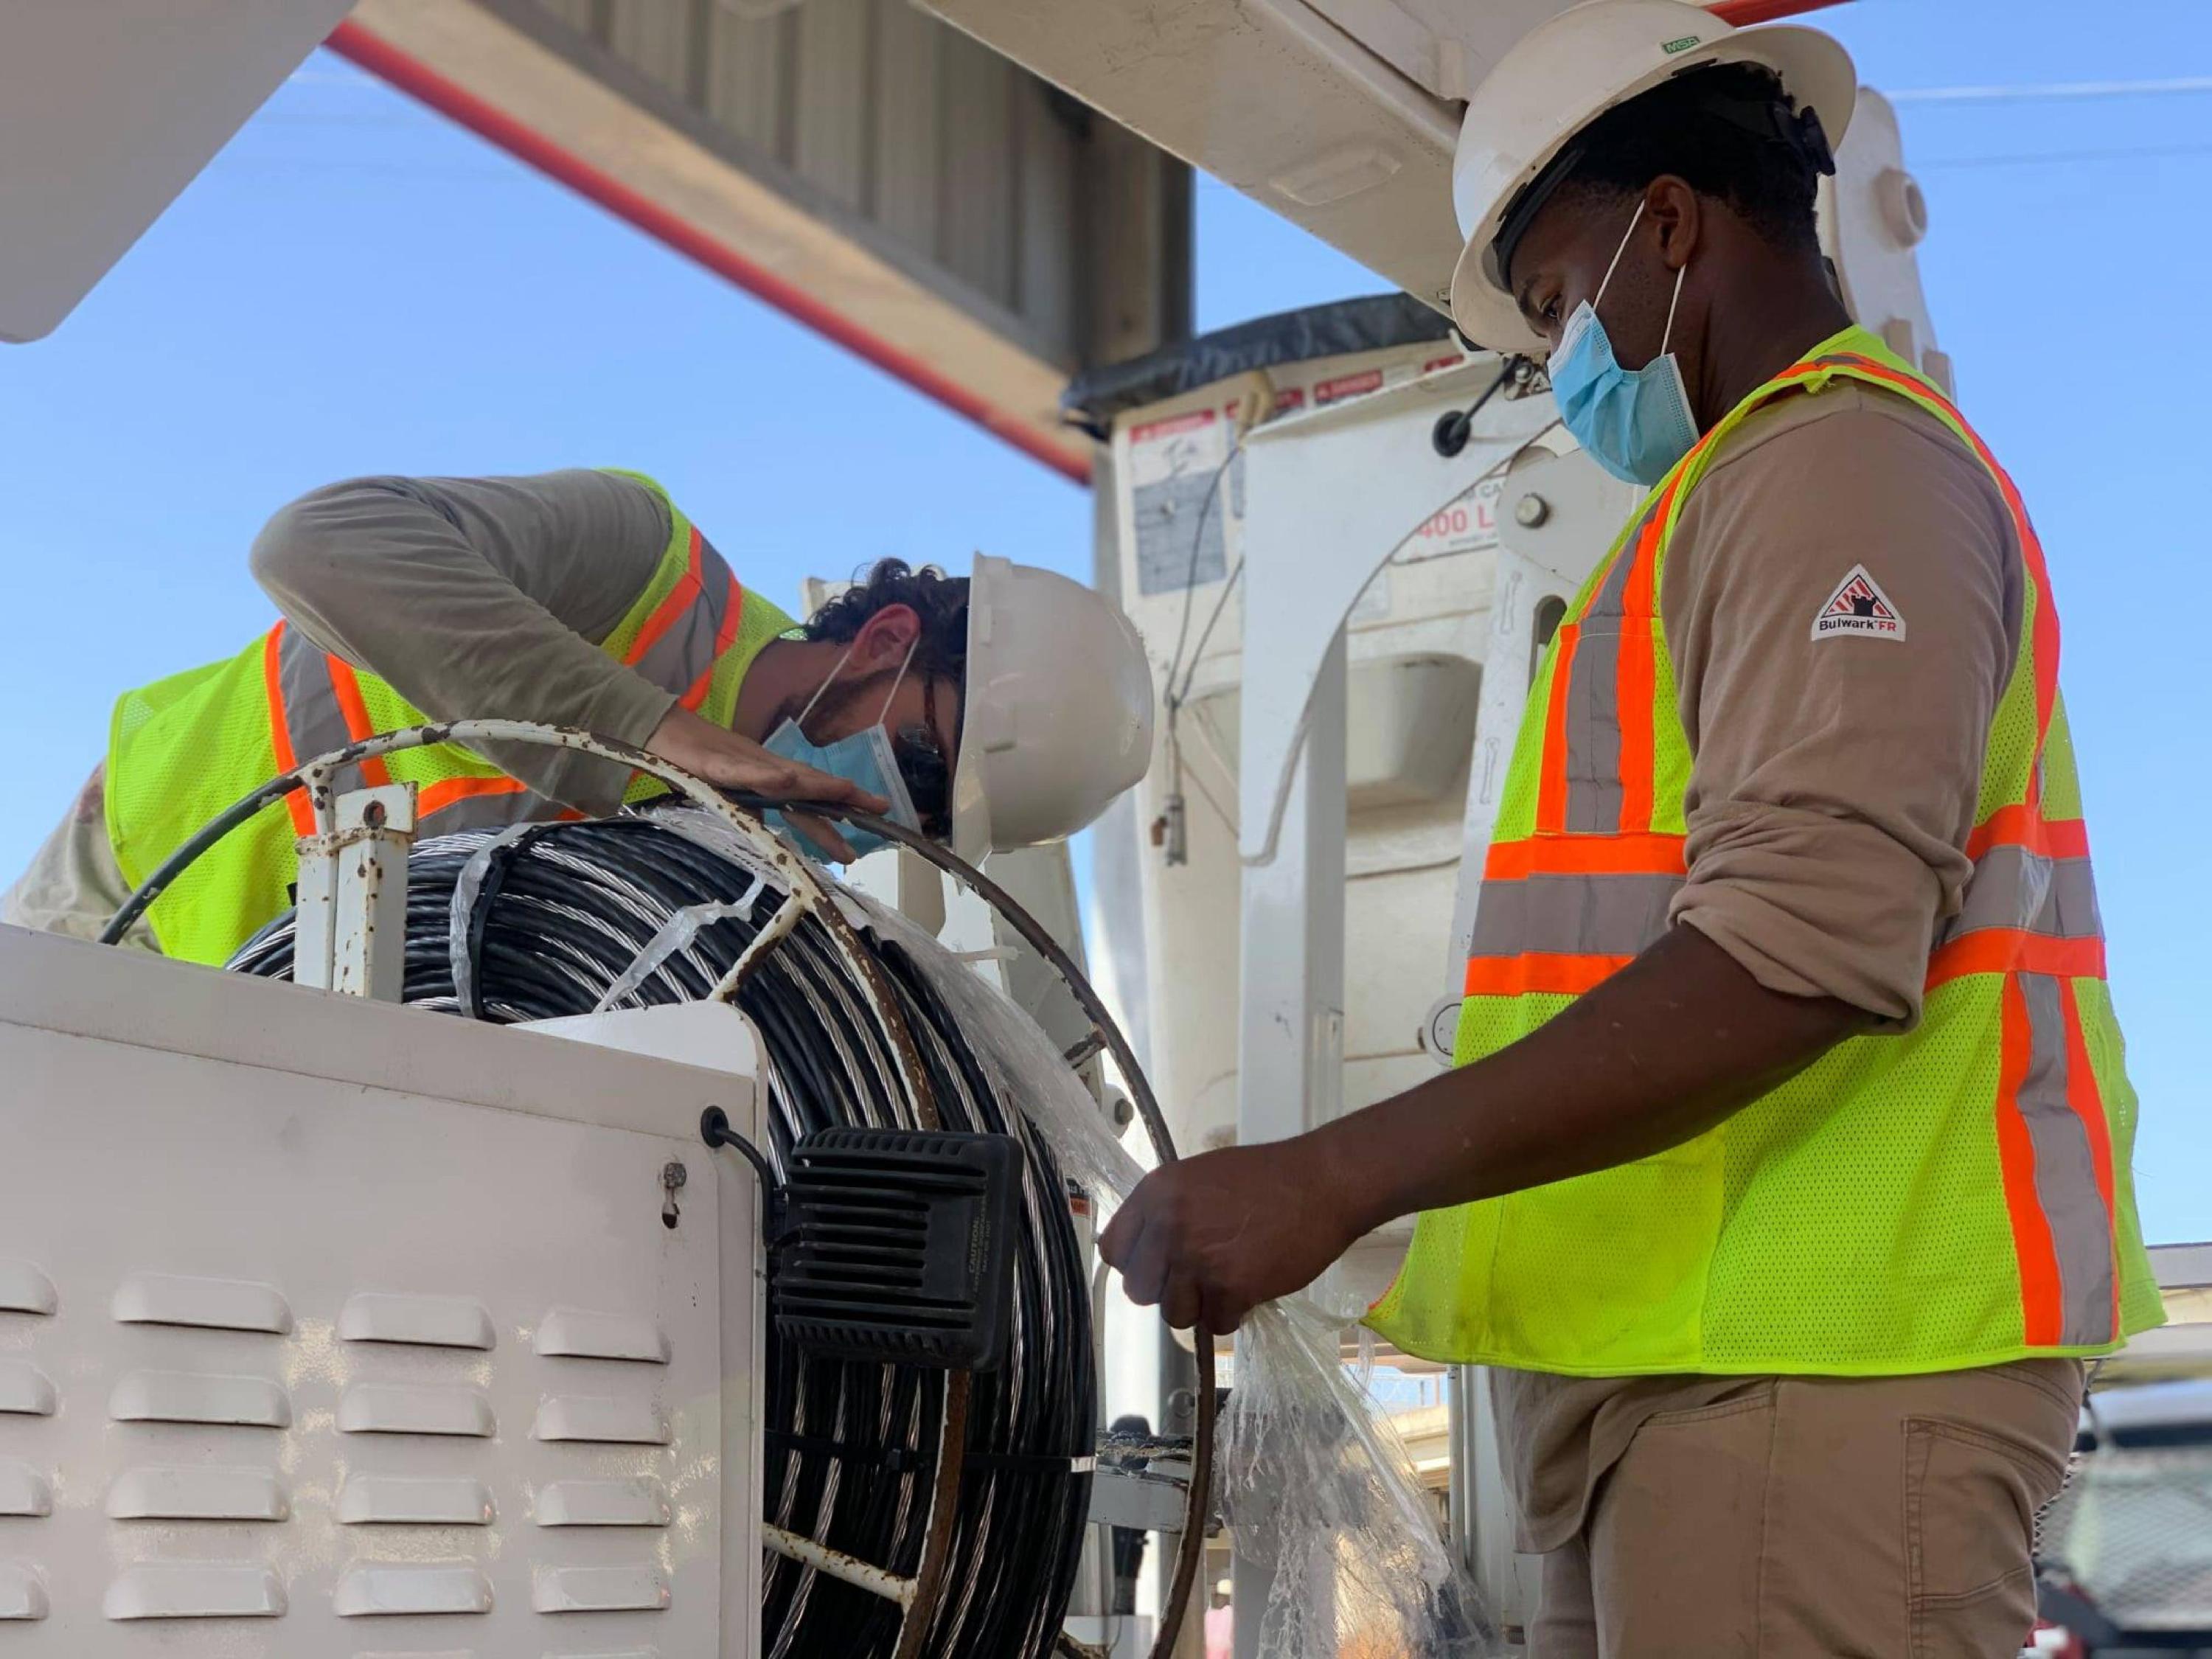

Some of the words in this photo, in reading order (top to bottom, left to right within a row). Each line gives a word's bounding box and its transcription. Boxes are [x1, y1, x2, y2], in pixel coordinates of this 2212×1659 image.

[1666, 38, 1698, 52] MSA
[1820, 618, 1874, 630] Bulwark
[1878, 621, 1896, 631] FR
